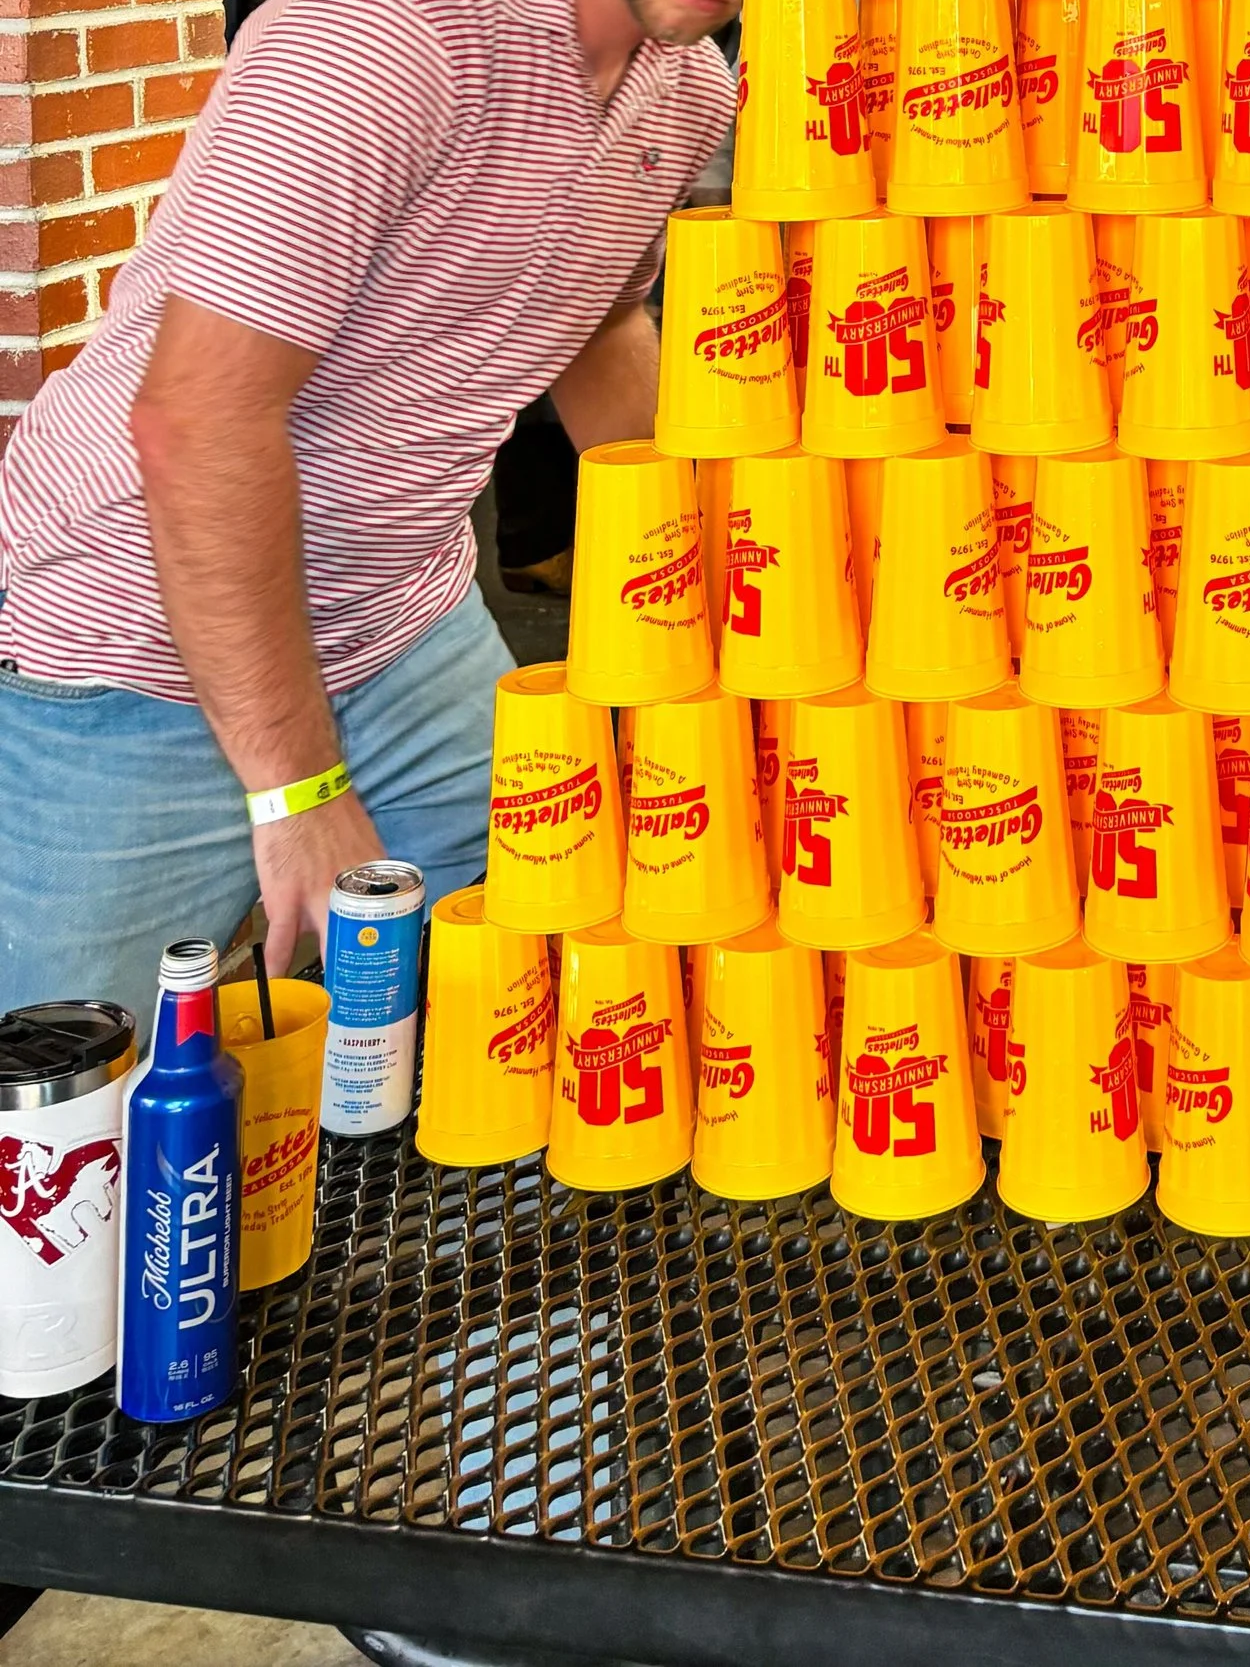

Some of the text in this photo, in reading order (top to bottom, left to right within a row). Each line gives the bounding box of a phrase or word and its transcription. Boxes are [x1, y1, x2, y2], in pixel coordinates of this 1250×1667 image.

[1115, 35, 1165, 58] Gallettes
[908, 66, 945, 75] Est. 1976
[922, 64, 999, 93] TUSCALOOSA
[1099, 67, 1178, 99] ANNIVERSARY
[907, 73, 1013, 121] Gallettes
[1083, 59, 1182, 153] 50 TH
[910, 124, 971, 148] Yellow Hammer!
[859, 274, 908, 300] Gallettes
[701, 305, 745, 315] Est. 1976
[842, 303, 921, 341] ANNIVERSARY
[824, 297, 926, 397] 50 TH
[708, 368, 747, 384] Hammer!
[629, 549, 673, 563] Est. 1976
[636, 614, 675, 630] Hammer!
[503, 779, 582, 806] TUSCALOOSA
[494, 784, 602, 834] Gallettes
[940, 804, 1042, 851] Gallettes
[494, 997, 534, 1018] Est. 1976
[595, 1001, 646, 1028] Gallettes
[577, 1029, 660, 1068] ANNIVERSARY
[868, 1033, 919, 1055] Gallettes
[562, 1028, 664, 1126] 50 TH
[852, 1062, 932, 1092] ANNIVERSARY
[853, 1054, 936, 1157] 50
[279, 1178, 296, 1193] Est.
[270, 1194, 304, 1226] Tradition
[222, 1172, 233, 1288] SUPERIOR LIGHT BEER
[141, 1189, 172, 1310] Michelob
[168, 1360, 189, 1371] 2.6
[203, 1348, 218, 1362] 95
